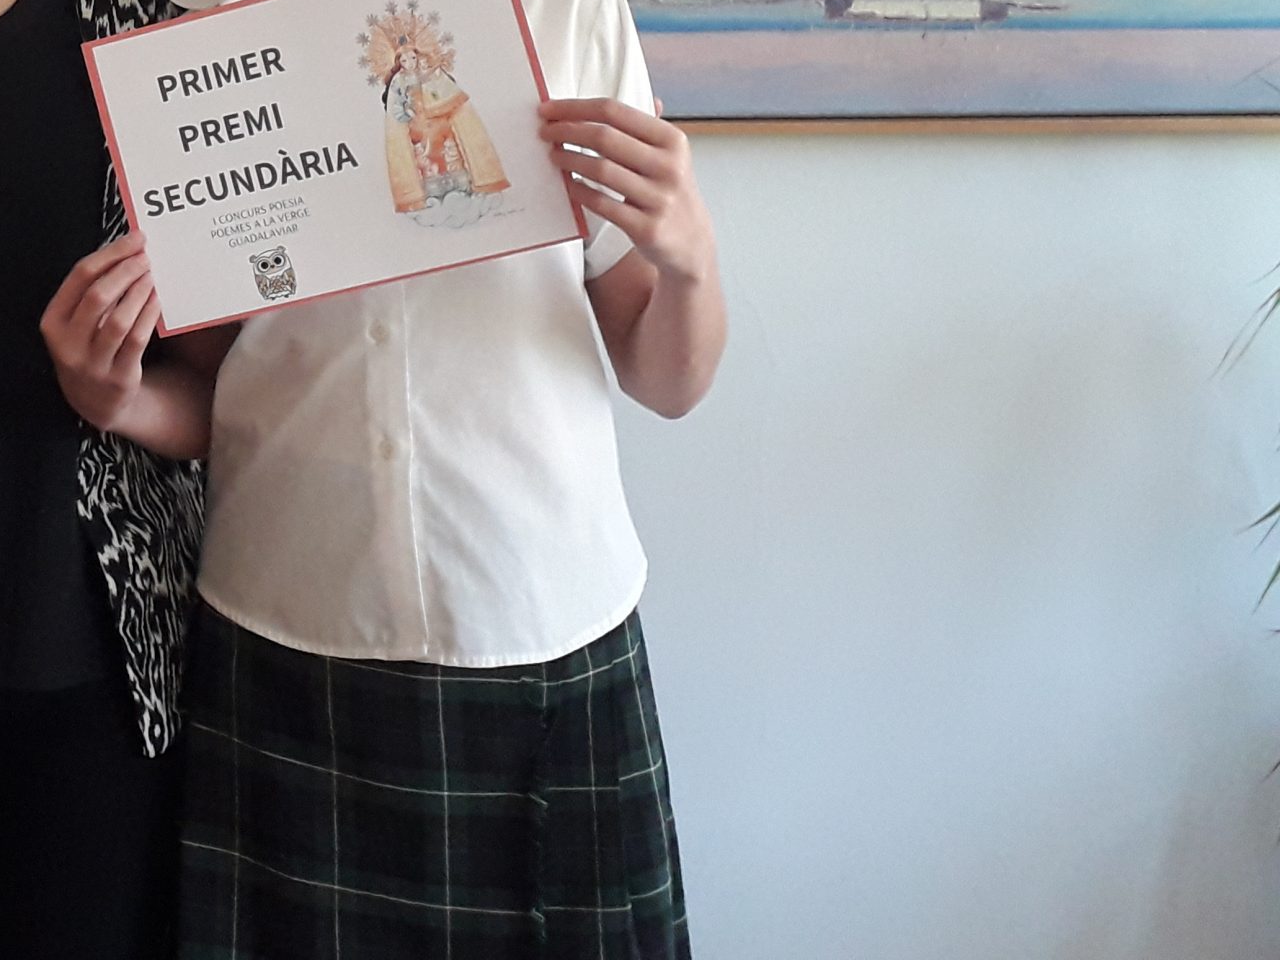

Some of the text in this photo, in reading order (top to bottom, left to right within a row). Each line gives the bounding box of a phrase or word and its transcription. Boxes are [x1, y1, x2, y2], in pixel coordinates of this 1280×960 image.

[157, 47, 286, 102] PRIMER
[178, 103, 283, 152] PREMI
[143, 142, 359, 217] SECUNDÀRIA
[211, 207, 311, 239] POEMES A LA VERGE
[218, 206, 267, 225] CONCURS
[269, 196, 305, 211] POESIA
[228, 223, 299, 248] GUADALAVIAR
